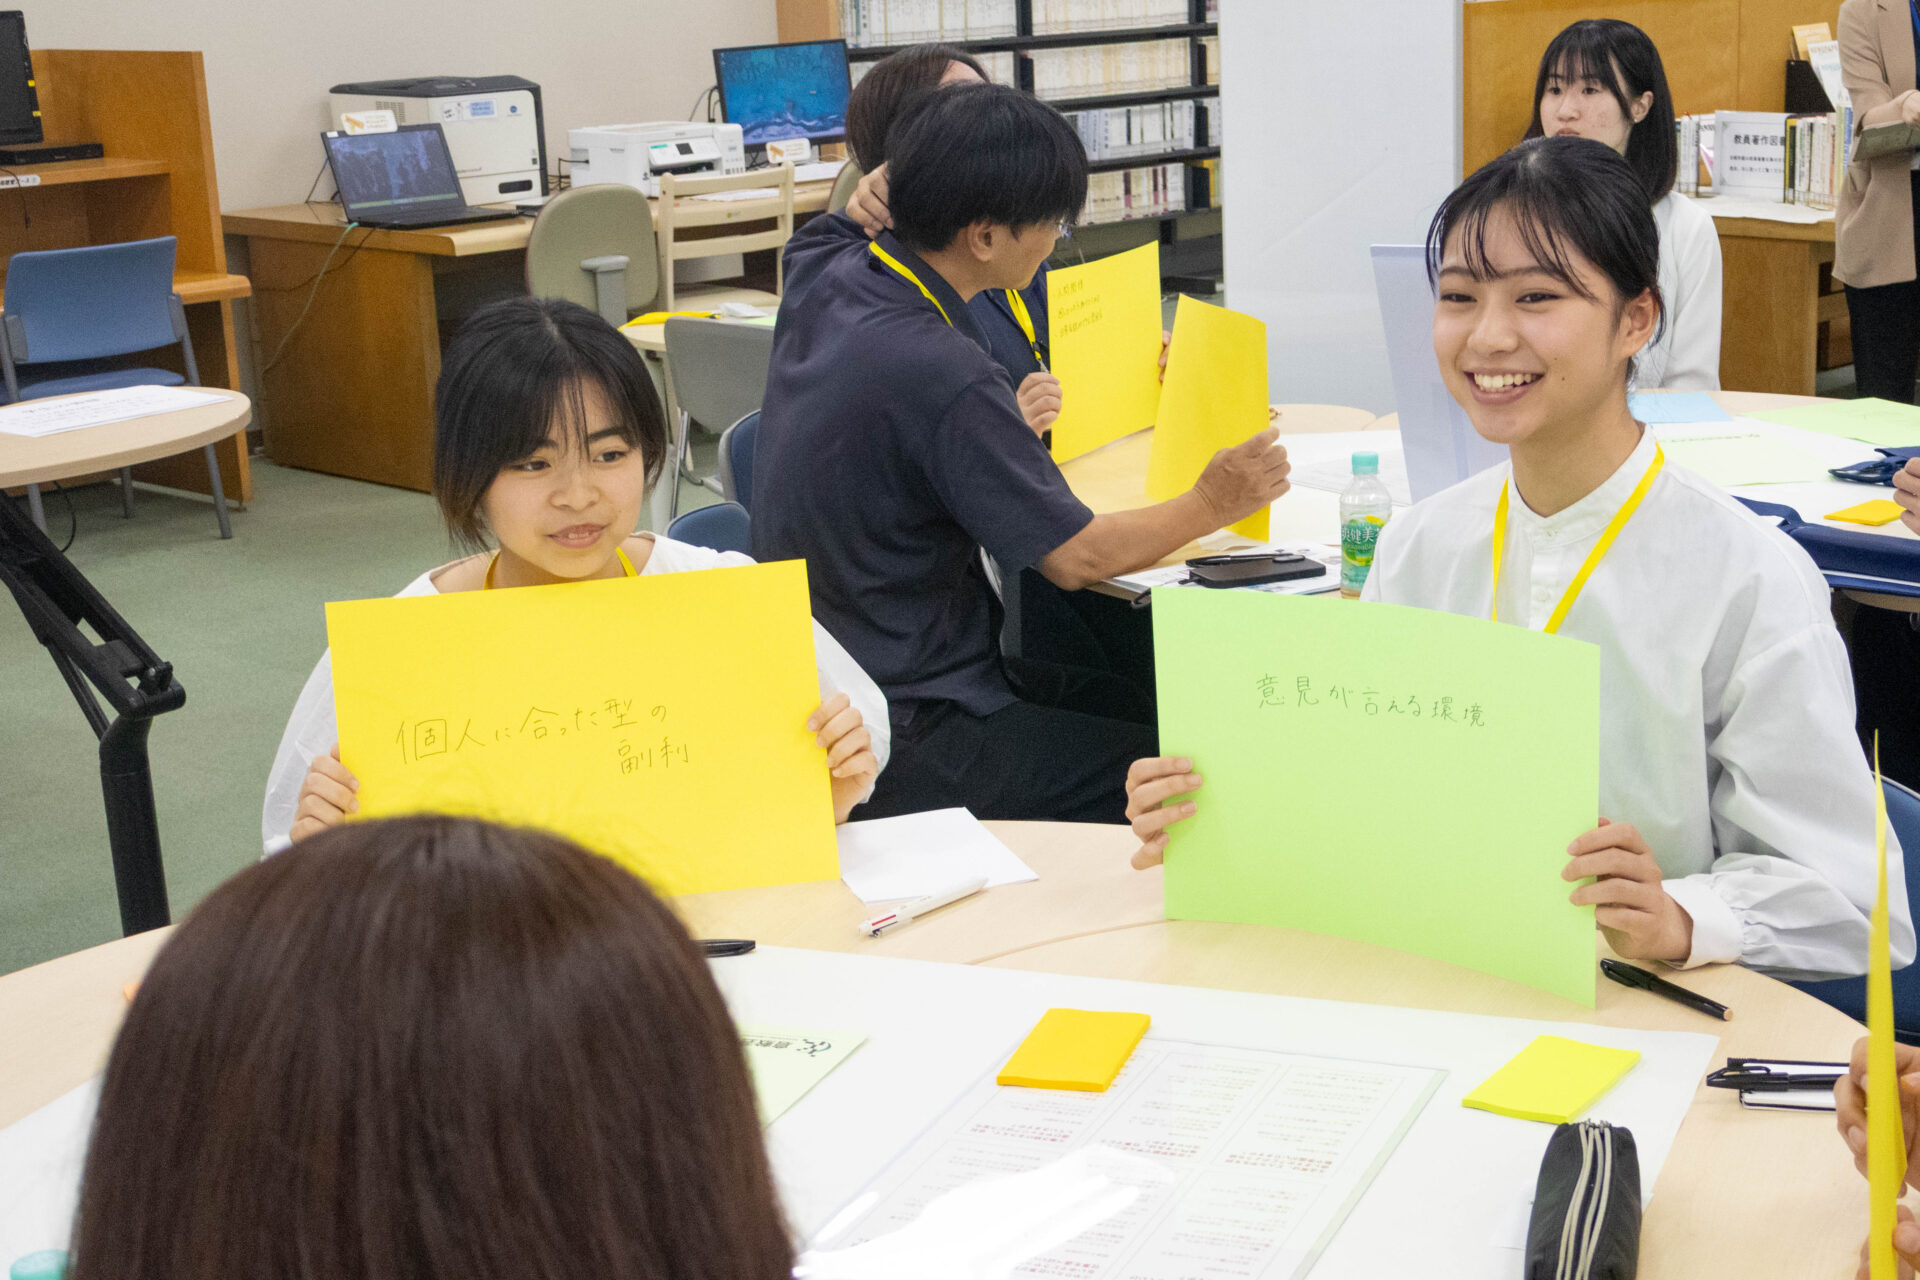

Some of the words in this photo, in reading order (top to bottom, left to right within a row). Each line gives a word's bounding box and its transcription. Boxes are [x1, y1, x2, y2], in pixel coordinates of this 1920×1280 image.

[1255, 673, 1486, 728] 意見が言える環境
[395, 698, 668, 766] 個人に合った型の
